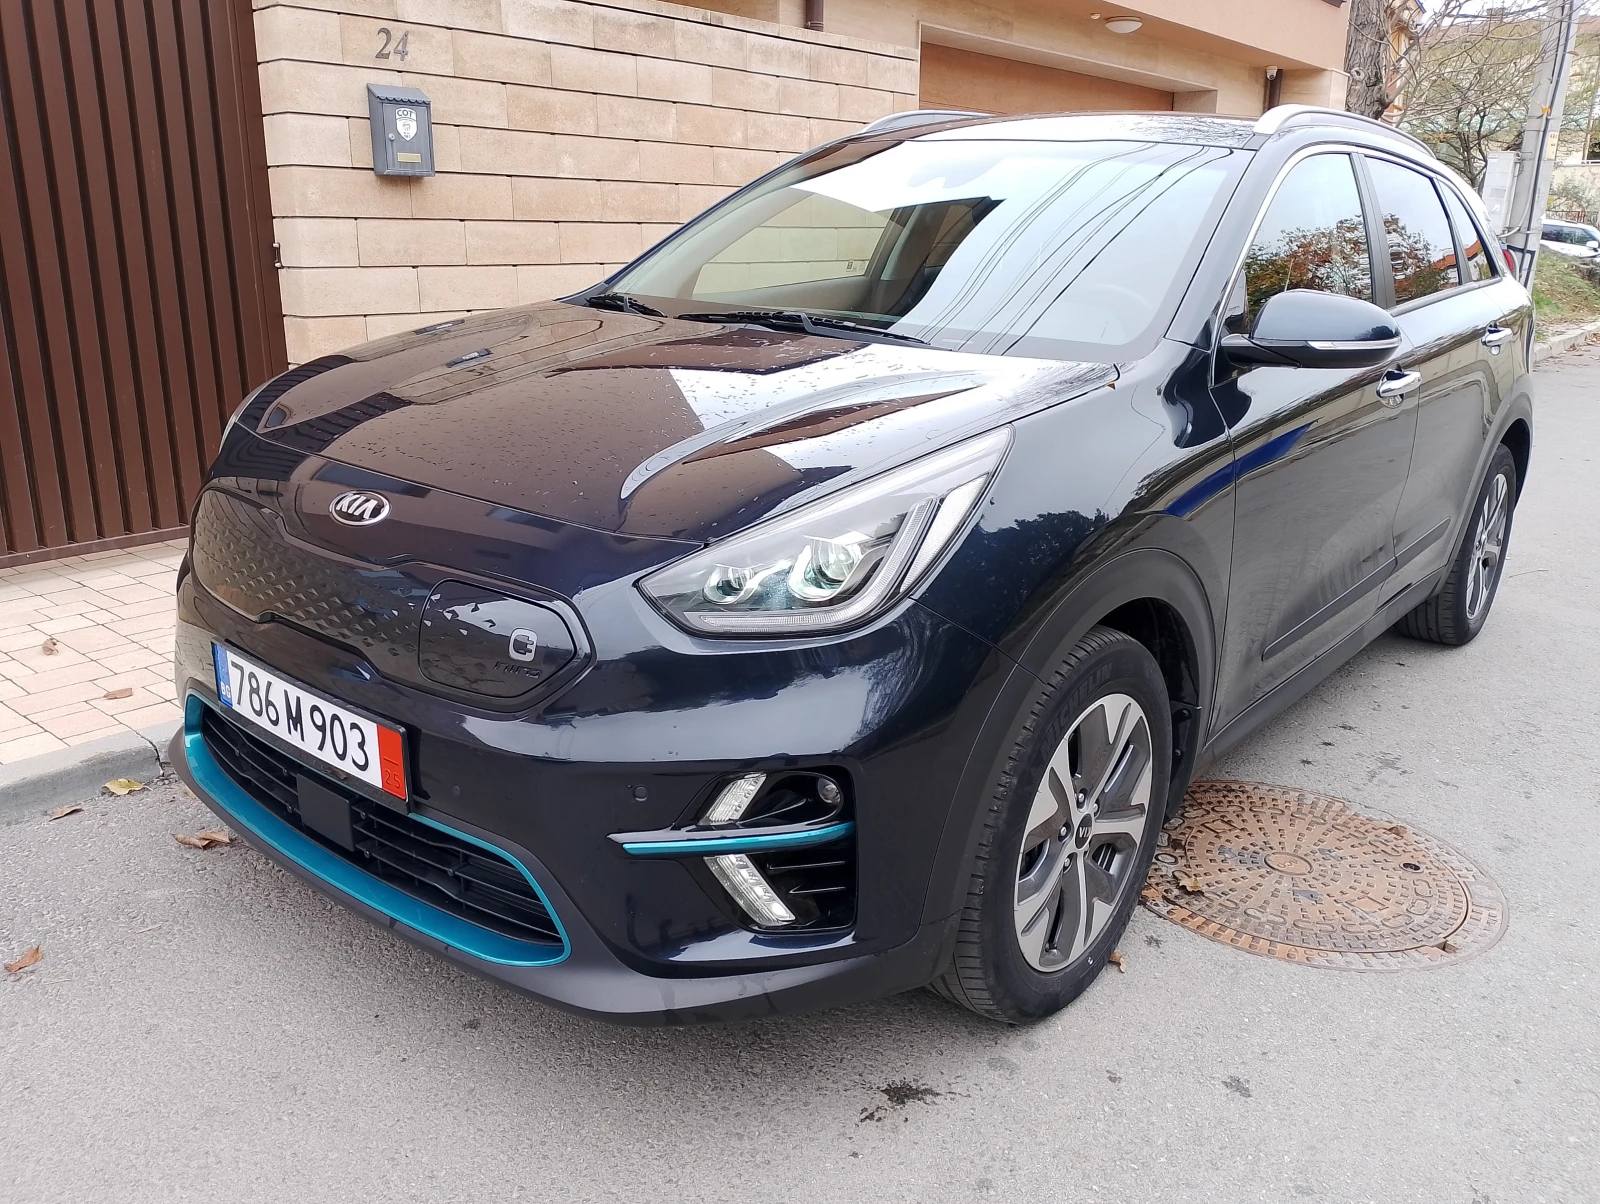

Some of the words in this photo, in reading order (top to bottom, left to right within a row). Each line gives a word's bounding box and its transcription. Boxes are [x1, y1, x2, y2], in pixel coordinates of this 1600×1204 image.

[375, 27, 409, 61] 24
[336, 494, 378, 519] KIA
[220, 681, 231, 698] BG
[230, 660, 280, 727] 786
[284, 689, 306, 743] M
[309, 704, 370, 772] 903
[384, 768, 401, 789] 25
